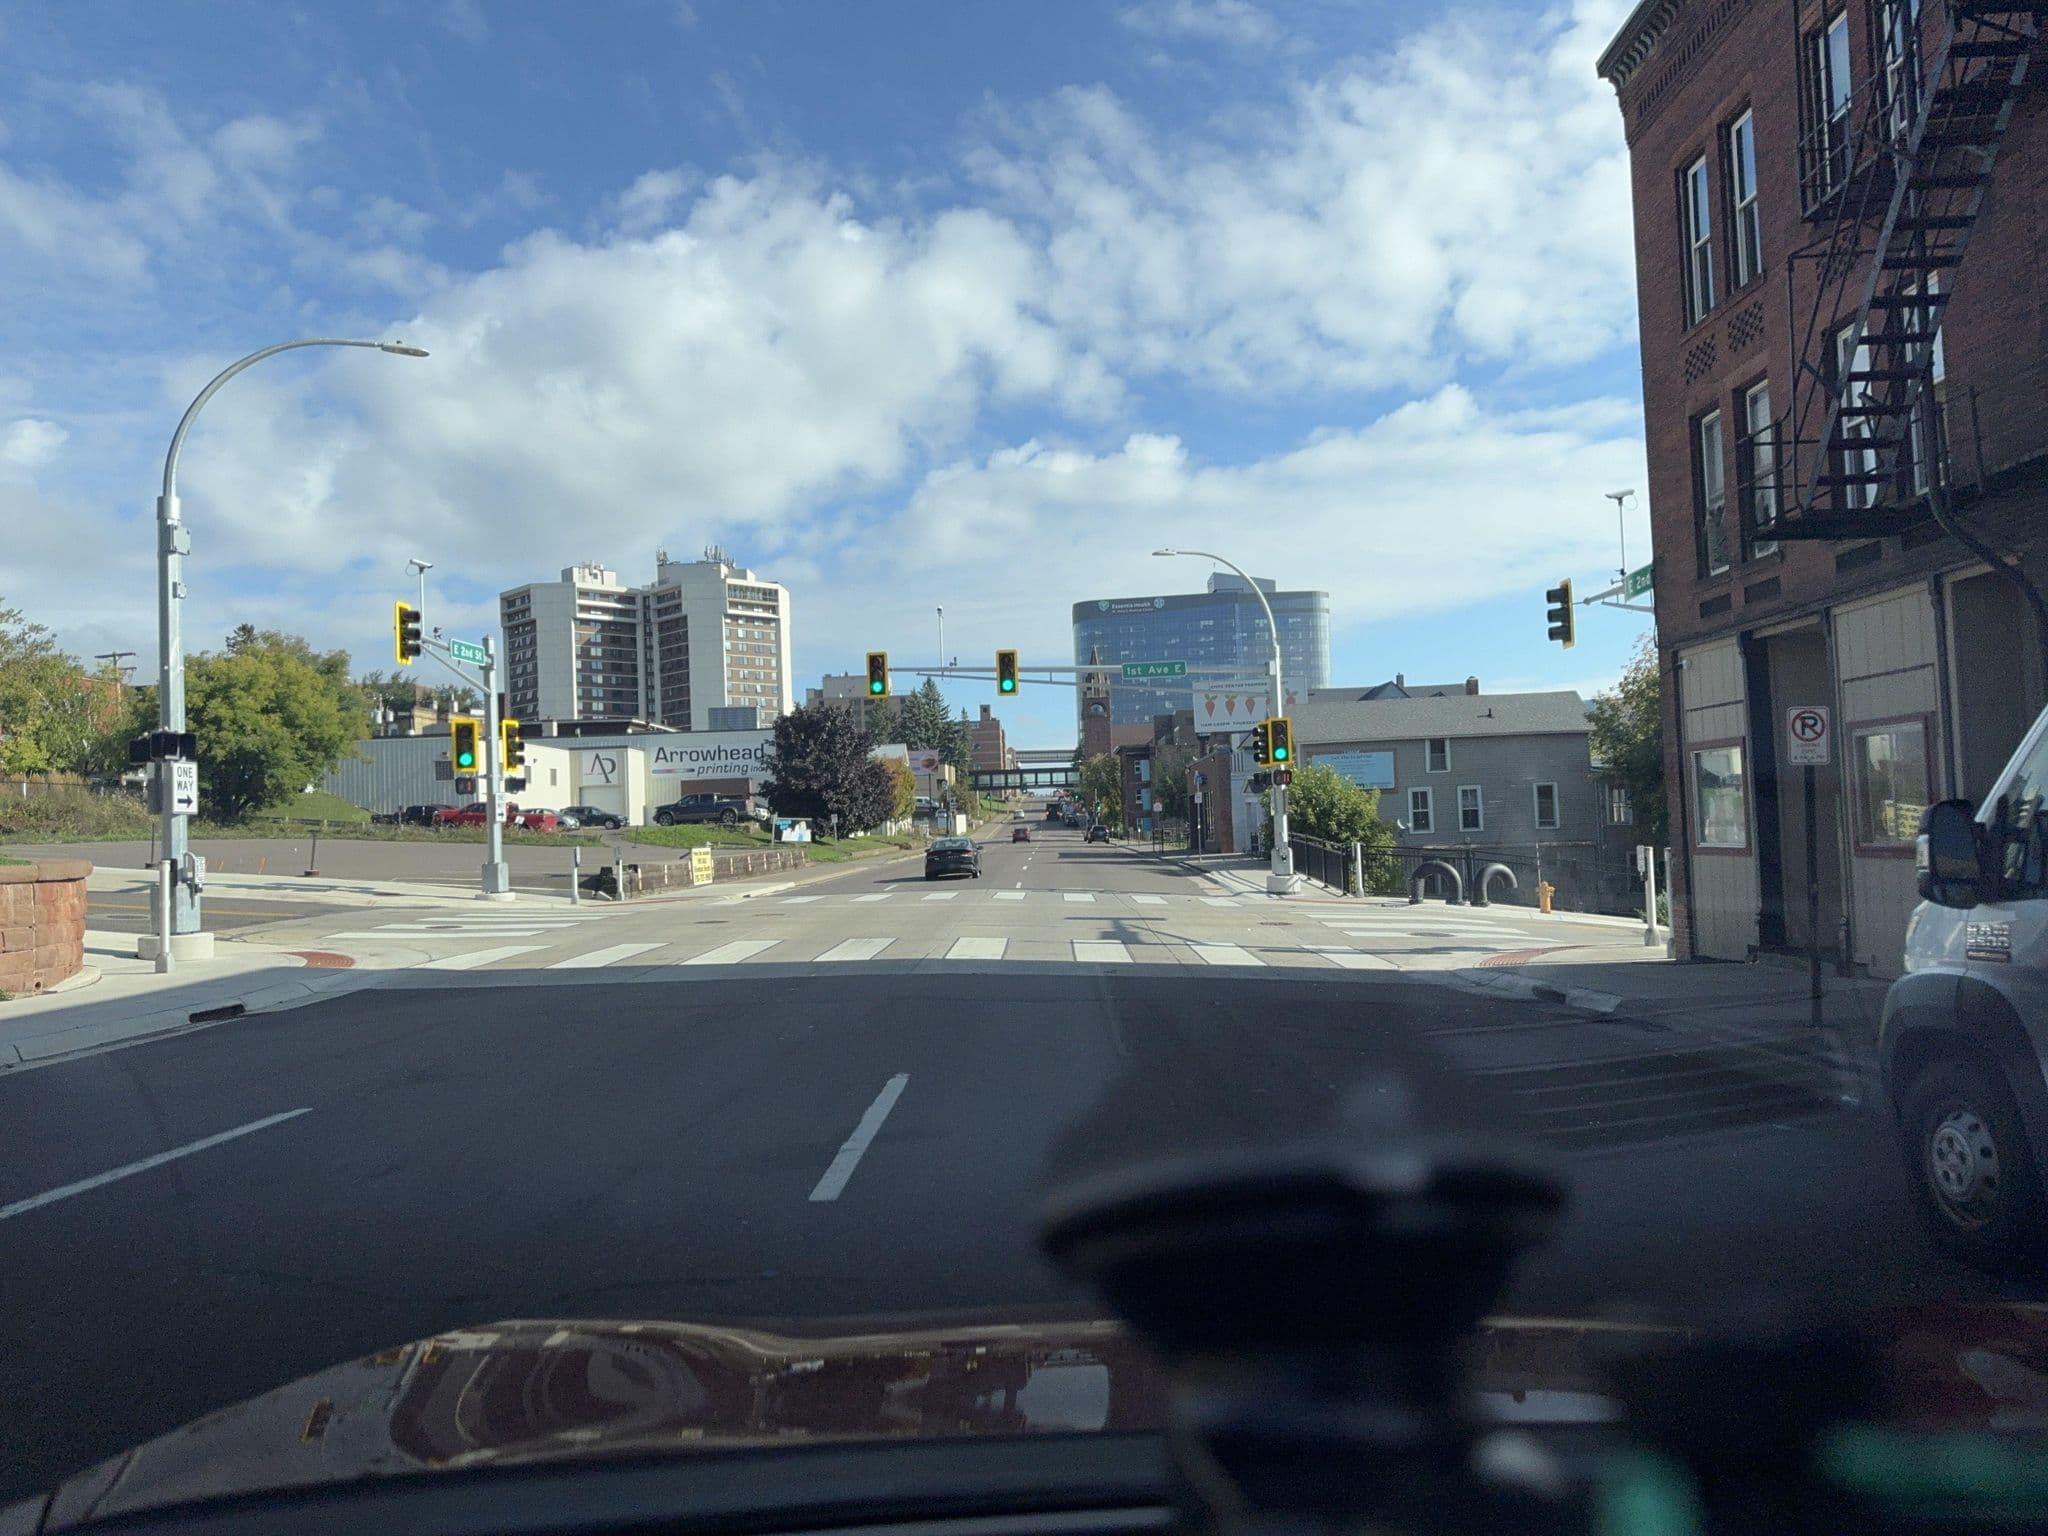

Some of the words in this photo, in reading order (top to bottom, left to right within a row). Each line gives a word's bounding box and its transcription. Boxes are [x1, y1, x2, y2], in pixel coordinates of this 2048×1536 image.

[454, 644, 460, 655] E
[461, 646, 474, 659] 2nd
[475, 649, 483, 661] St
[1127, 665, 1142, 676] 1st
[1148, 665, 1169, 675] Ave
[1174, 663, 1182, 673] E
[655, 743, 765, 763] Arrowhead
[177, 766, 193, 778] ONE
[697, 762, 749, 777] printing
[177, 780, 193, 791] WAY
